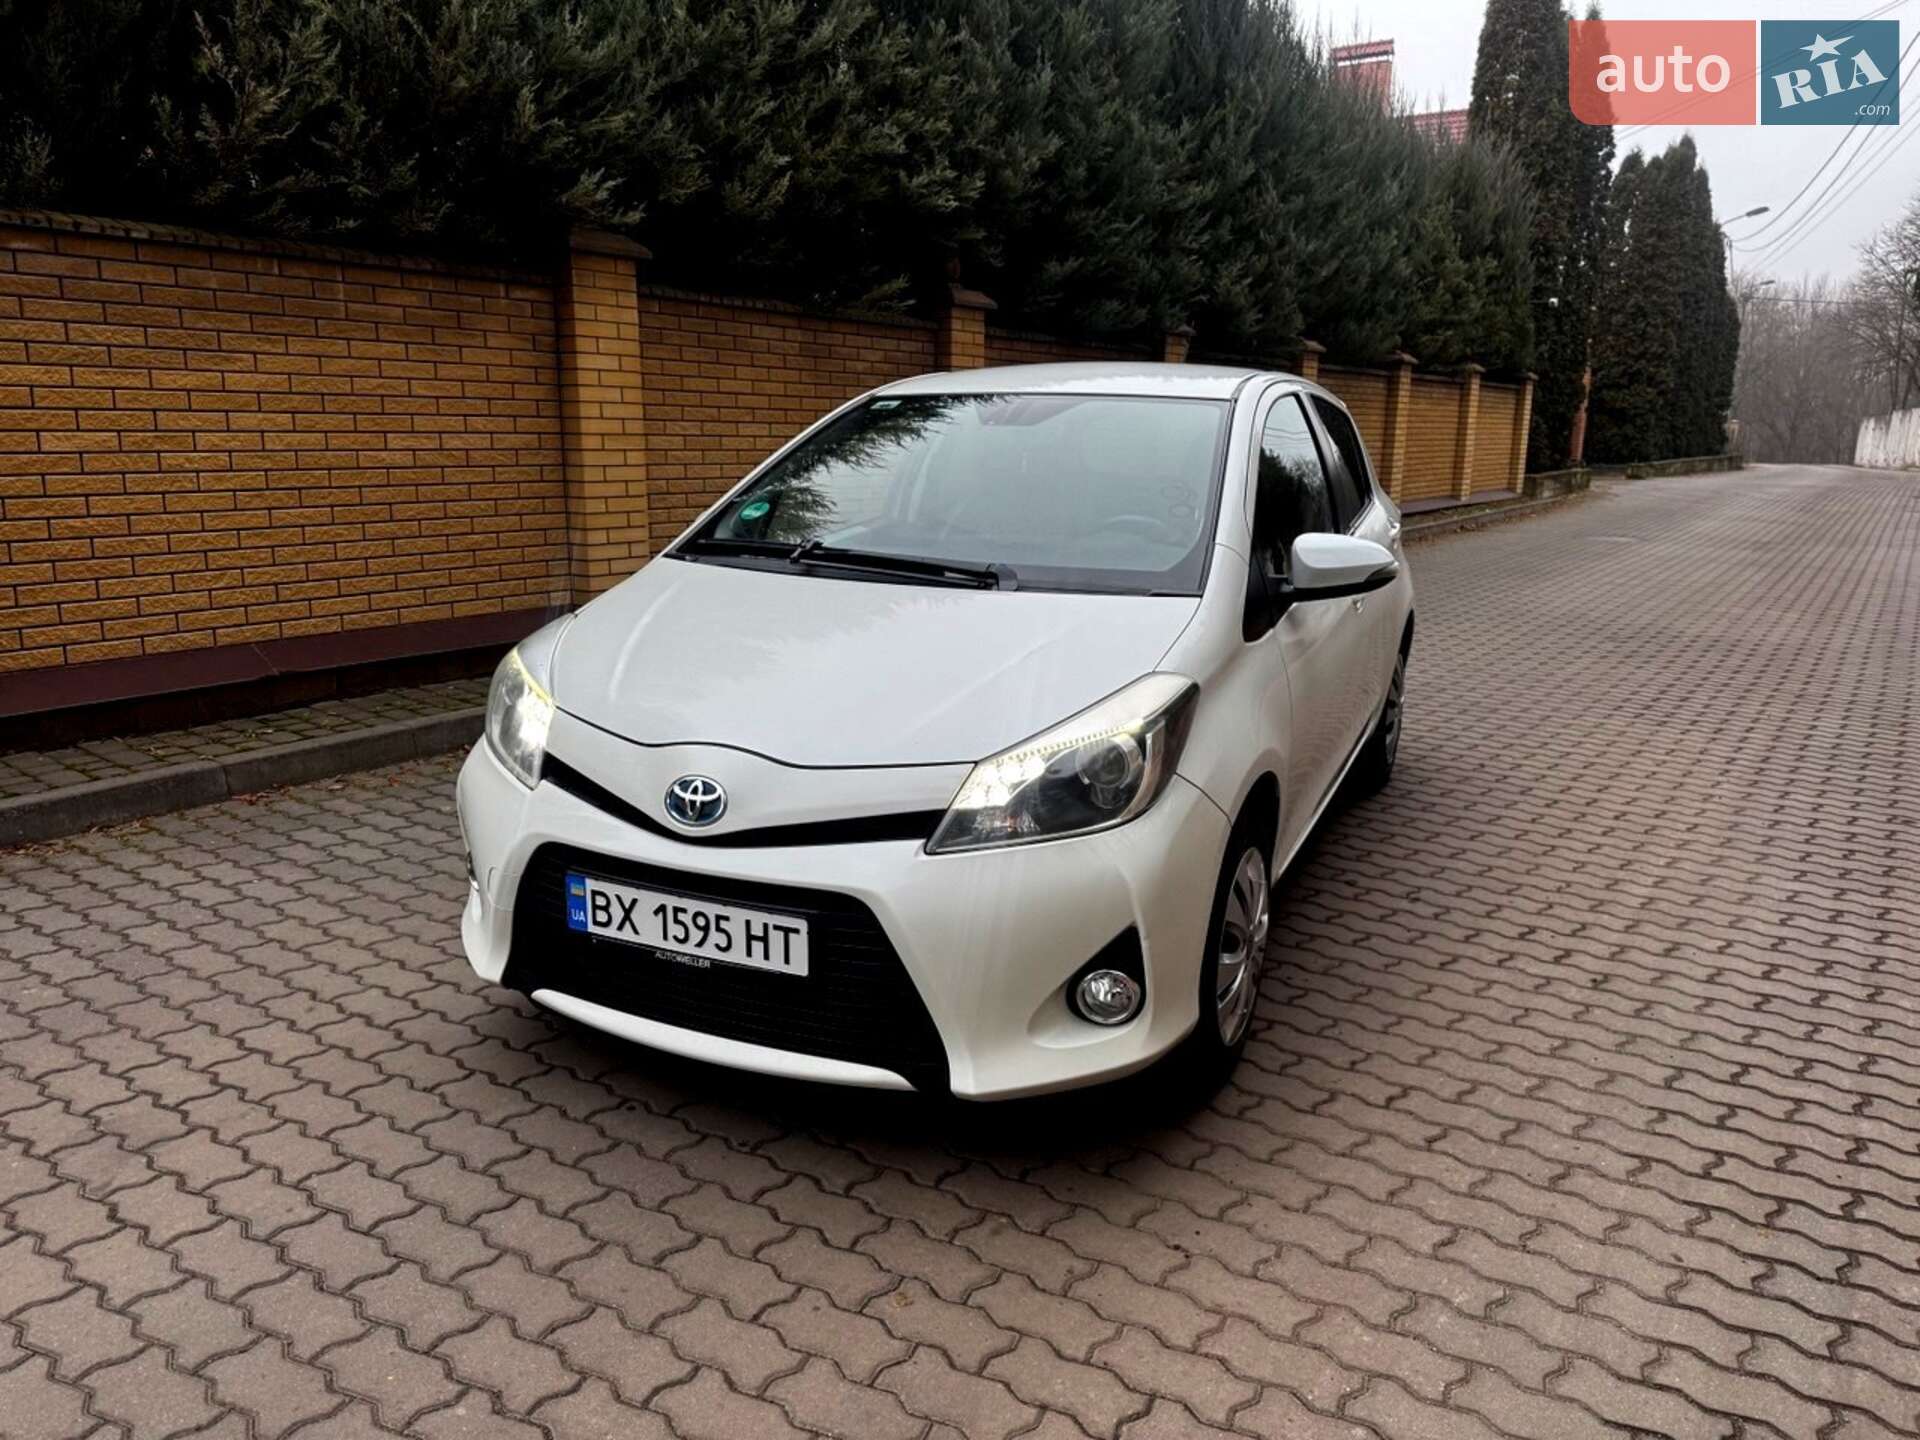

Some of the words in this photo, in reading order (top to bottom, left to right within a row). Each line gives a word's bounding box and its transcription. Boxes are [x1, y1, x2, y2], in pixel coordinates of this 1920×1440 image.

[571, 909, 586, 922] UA
[591, 890, 639, 935] BX
[653, 903, 732, 952] 1595
[745, 919, 800, 965] HT
